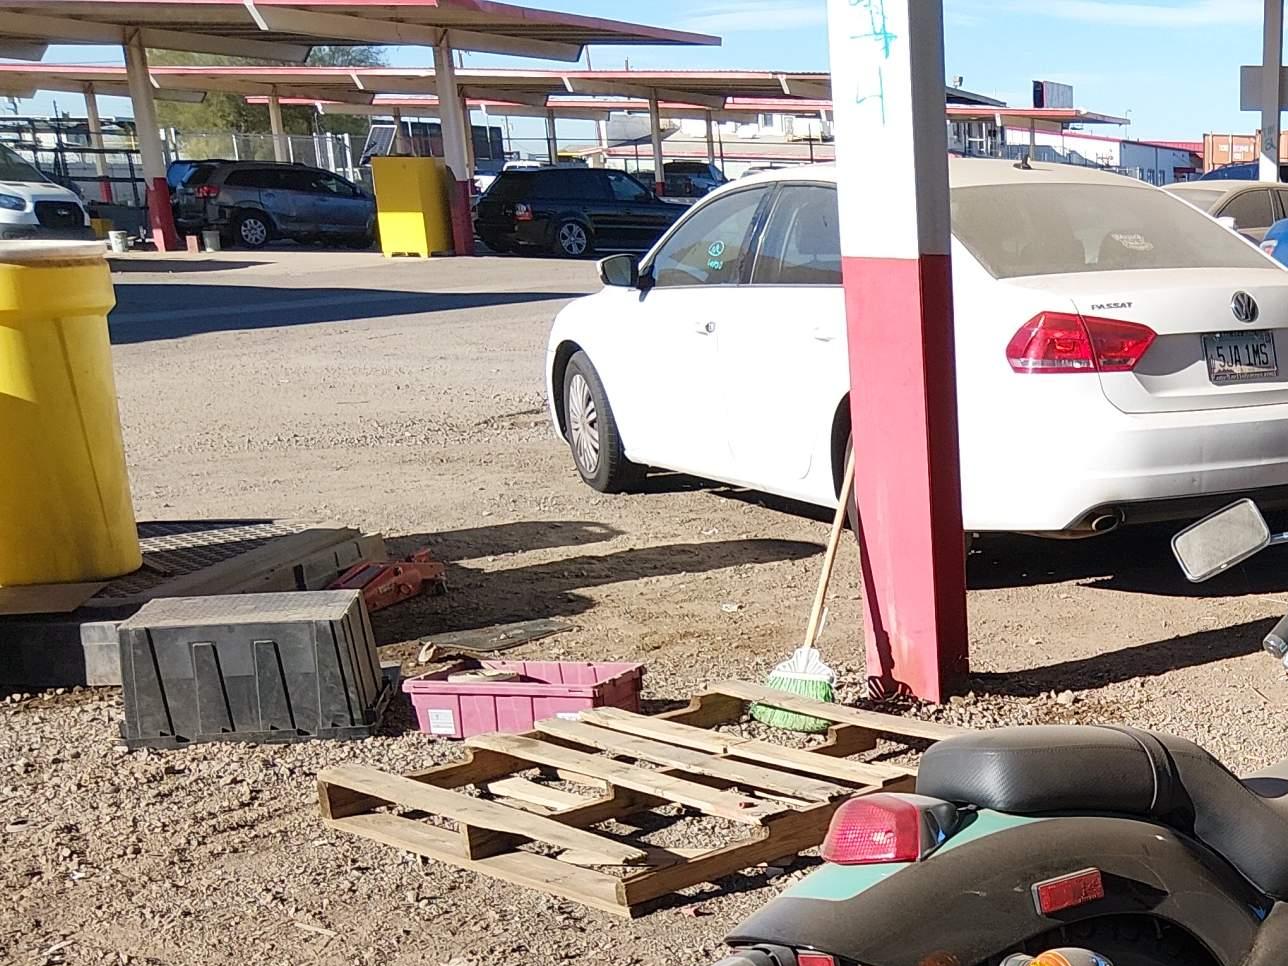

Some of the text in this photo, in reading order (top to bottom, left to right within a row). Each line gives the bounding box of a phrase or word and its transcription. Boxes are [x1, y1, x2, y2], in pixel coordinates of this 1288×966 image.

[1090, 302, 1133, 311] PASSAT
[1216, 343, 1269, 368] 5JA 1MS
